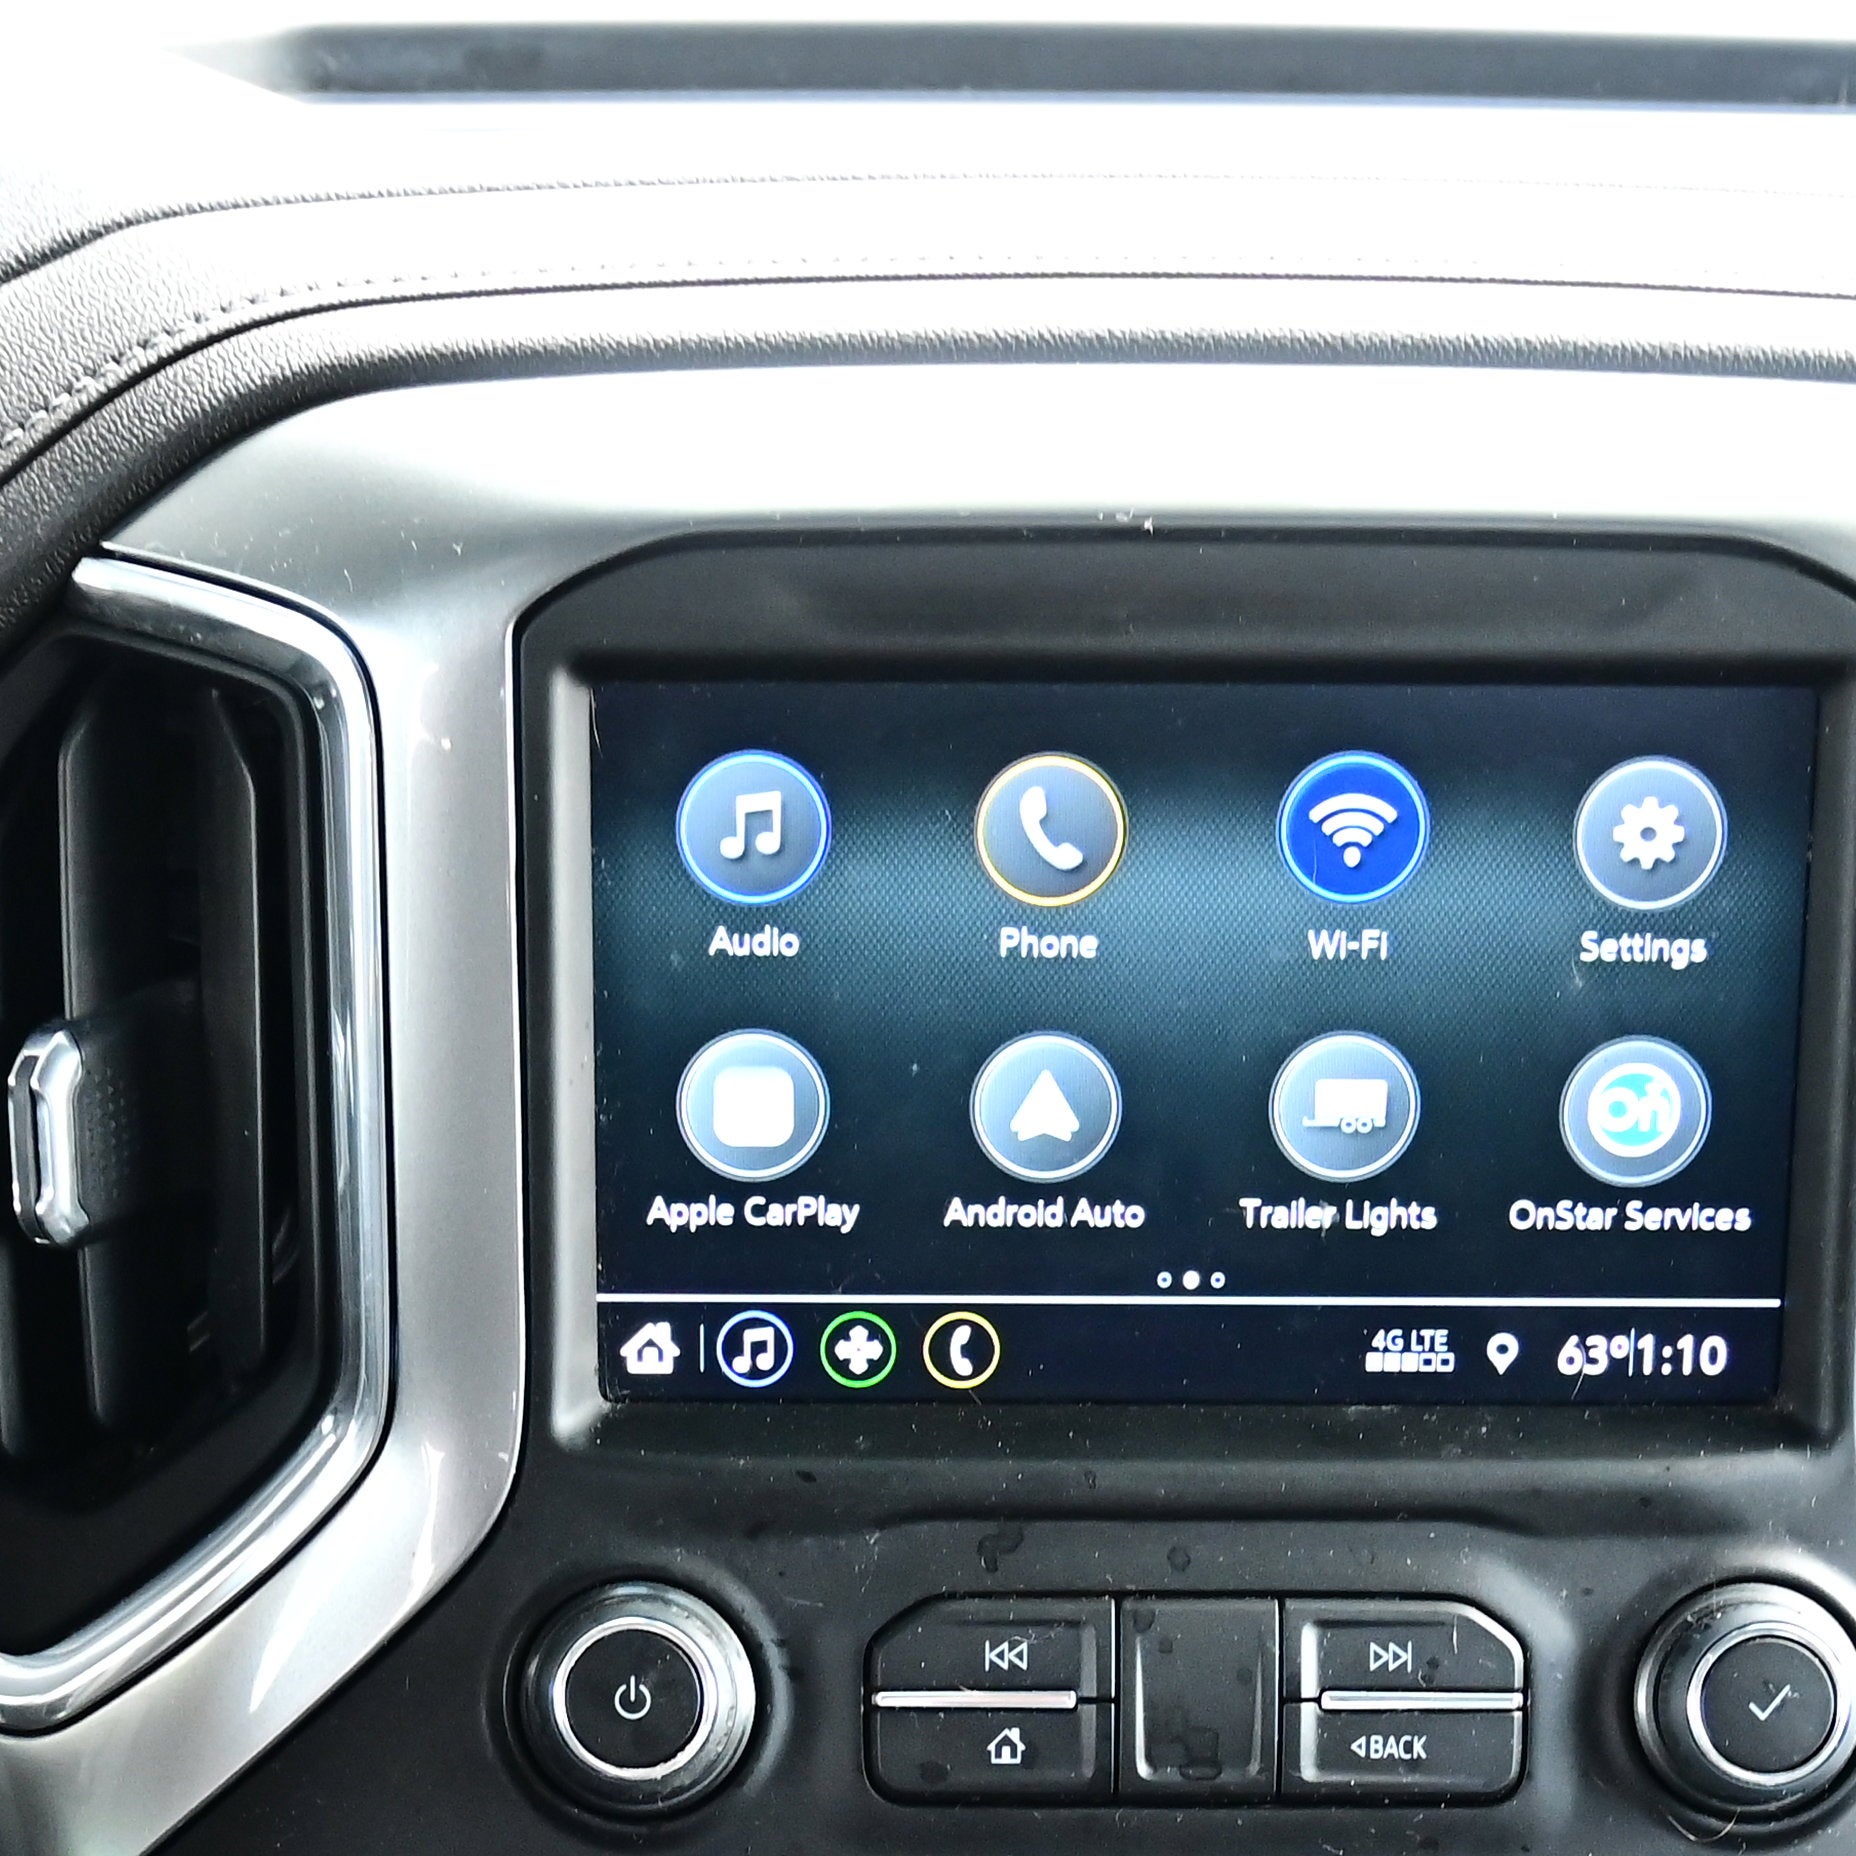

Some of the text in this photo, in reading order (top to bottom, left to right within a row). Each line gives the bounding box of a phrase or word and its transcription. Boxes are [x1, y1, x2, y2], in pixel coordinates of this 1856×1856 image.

[708, 923, 800, 957] Audio
[999, 925, 1100, 959] Phone
[1307, 928, 1389, 961] Wi-Fi
[1578, 930, 1708, 970] Settings
[646, 1194, 861, 1234] Apple CarPlay
[943, 1195, 1146, 1229] Android Auto
[1238, 1197, 1438, 1237] Trailer Lights
[1509, 1199, 1752, 1232] OnStar Services
[1370, 1324, 1450, 1352] 4G LTE
[1636, 1333, 1728, 1376] 1:10
[1369, 1734, 1427, 1760] BACK
